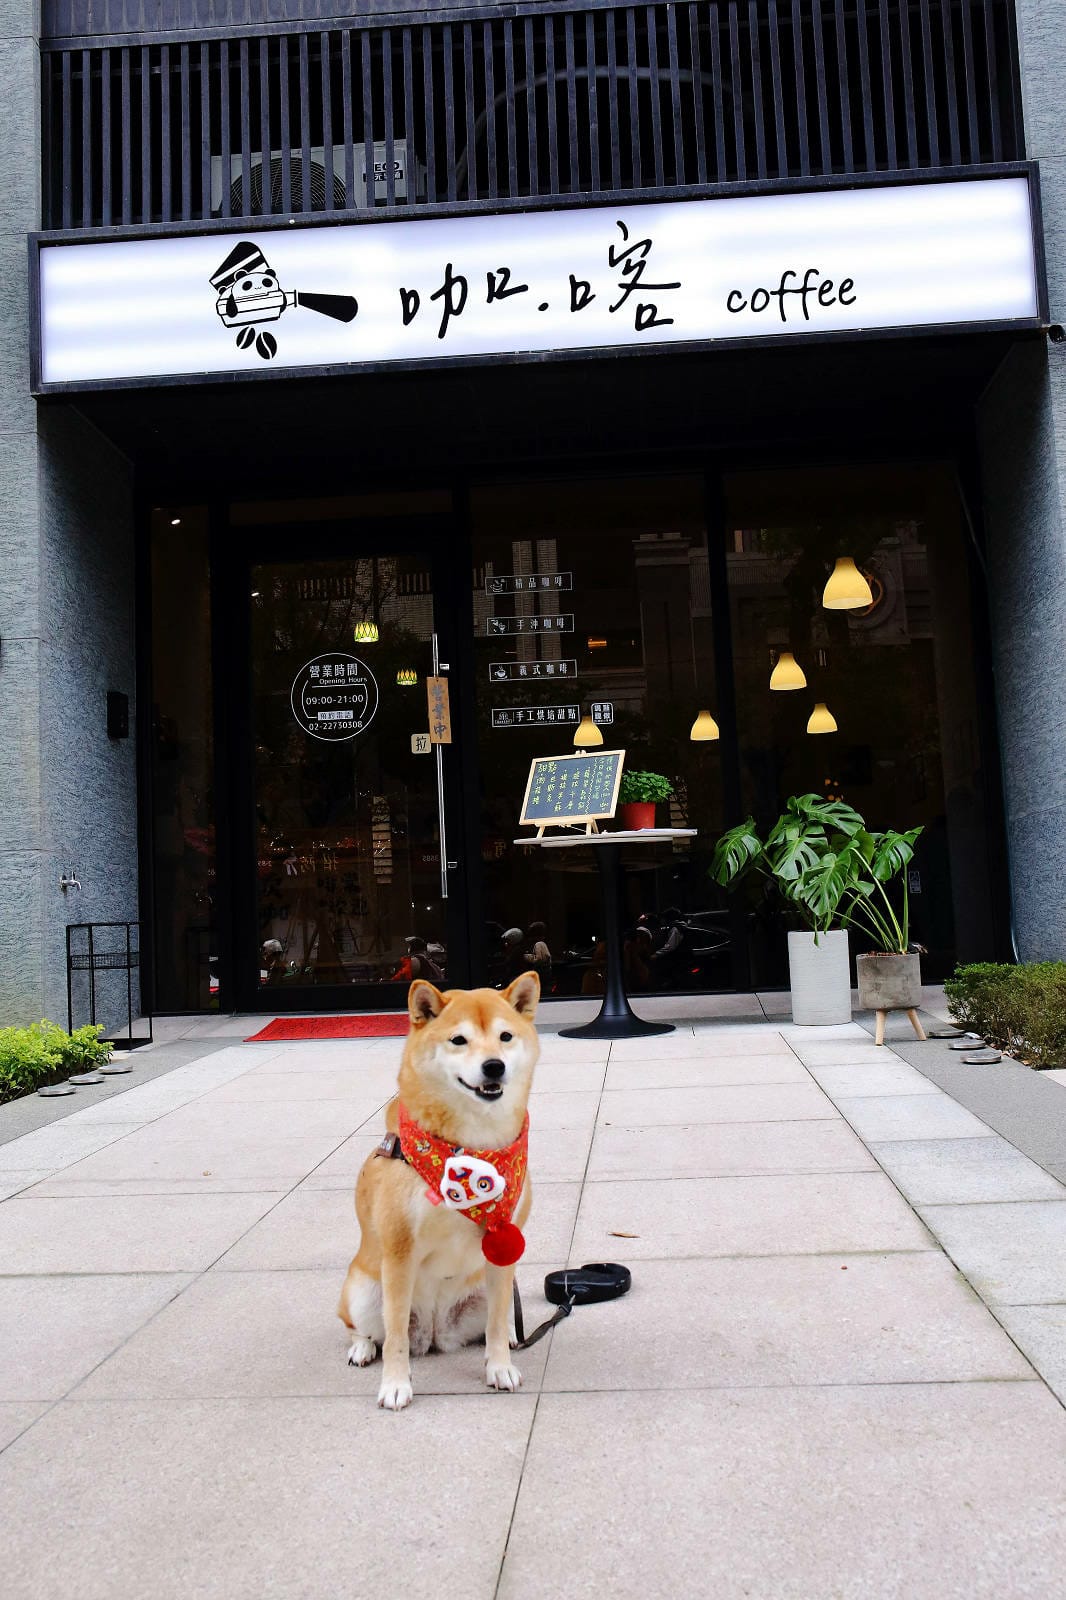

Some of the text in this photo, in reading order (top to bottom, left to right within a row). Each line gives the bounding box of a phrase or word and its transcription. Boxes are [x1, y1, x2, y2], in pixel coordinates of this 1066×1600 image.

[727, 269, 856, 322] coffee
[515, 576, 562, 589] 精品咖啡
[516, 617, 566, 631] 手沖咖啡
[309, 663, 358, 678] 營業時間
[519, 662, 568, 677] 義式咖啡
[319, 676, 368, 686] Opening Hours
[305, 694, 364, 706] 09:00-21:00
[515, 708, 577, 722] 手工烘焙甜點
[308, 721, 363, 732] 02-22730308
[415, 735, 427, 751] 拉
